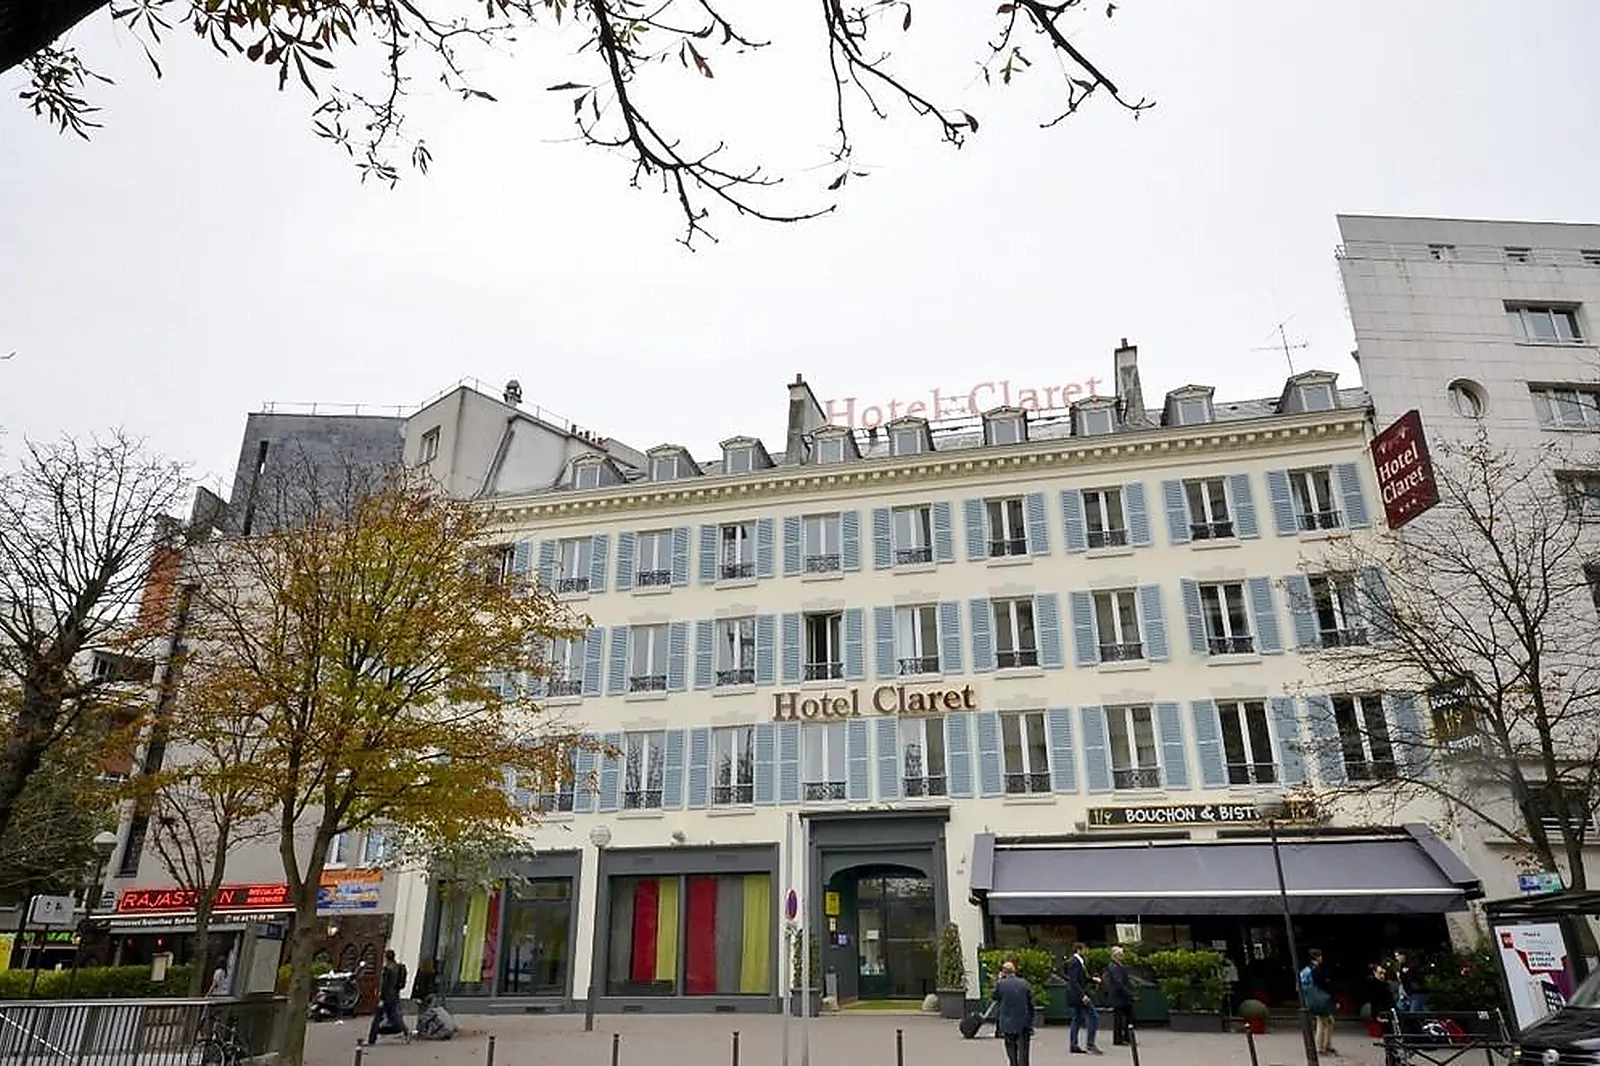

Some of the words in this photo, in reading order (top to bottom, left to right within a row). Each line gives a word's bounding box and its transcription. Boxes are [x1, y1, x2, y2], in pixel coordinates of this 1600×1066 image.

[825, 387, 941, 429] Hotel
[967, 375, 1103, 418] Claret
[1378, 440, 1419, 483] Hotel
[1382, 465, 1426, 505] Claret
[773, 688, 860, 722] Hotel
[873, 684, 976, 715] Claret
[1126, 807, 1196, 823] BOUCHON
[1201, 806, 1216, 822] &
